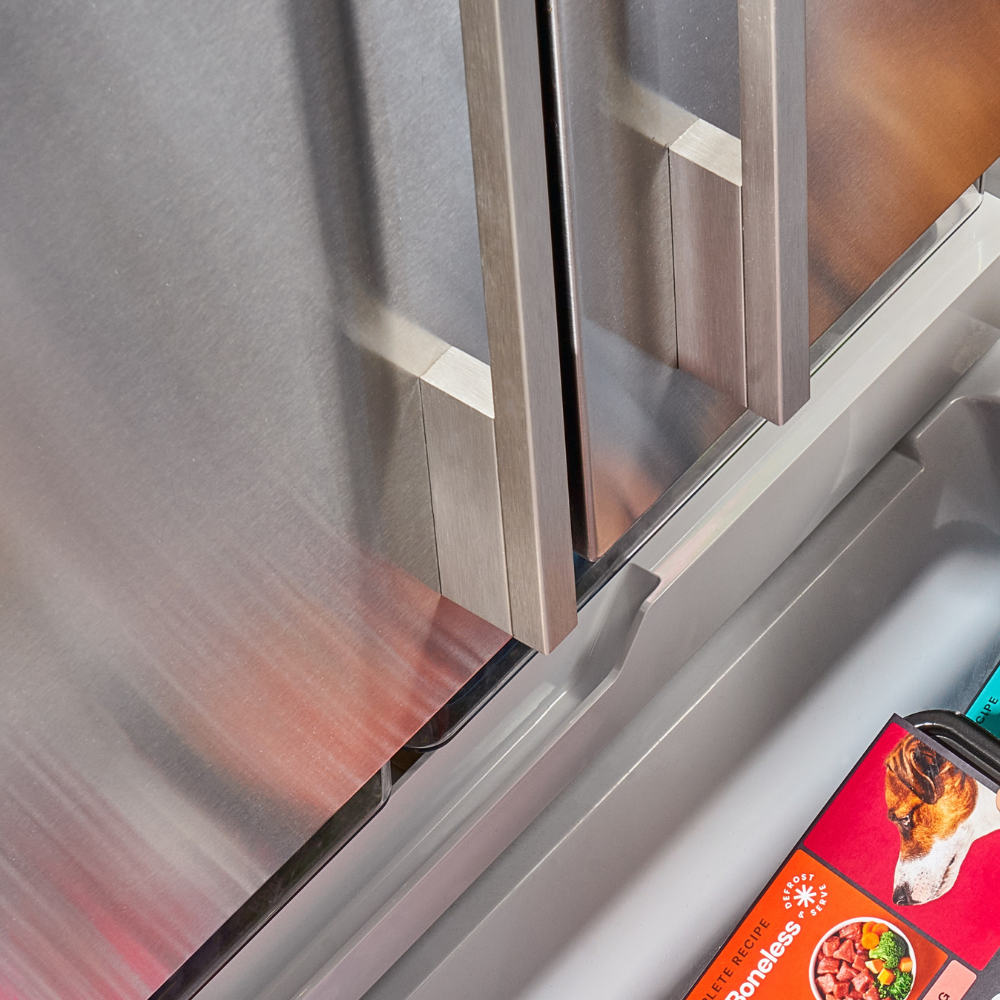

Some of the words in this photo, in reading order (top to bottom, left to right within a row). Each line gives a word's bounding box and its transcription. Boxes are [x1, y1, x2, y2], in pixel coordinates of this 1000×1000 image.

[975, 696, 999, 725] CIPE
[783, 873, 815, 909] DEFROST
[811, 884, 828, 916] SERVE
[731, 919, 770, 966] RECIPE
